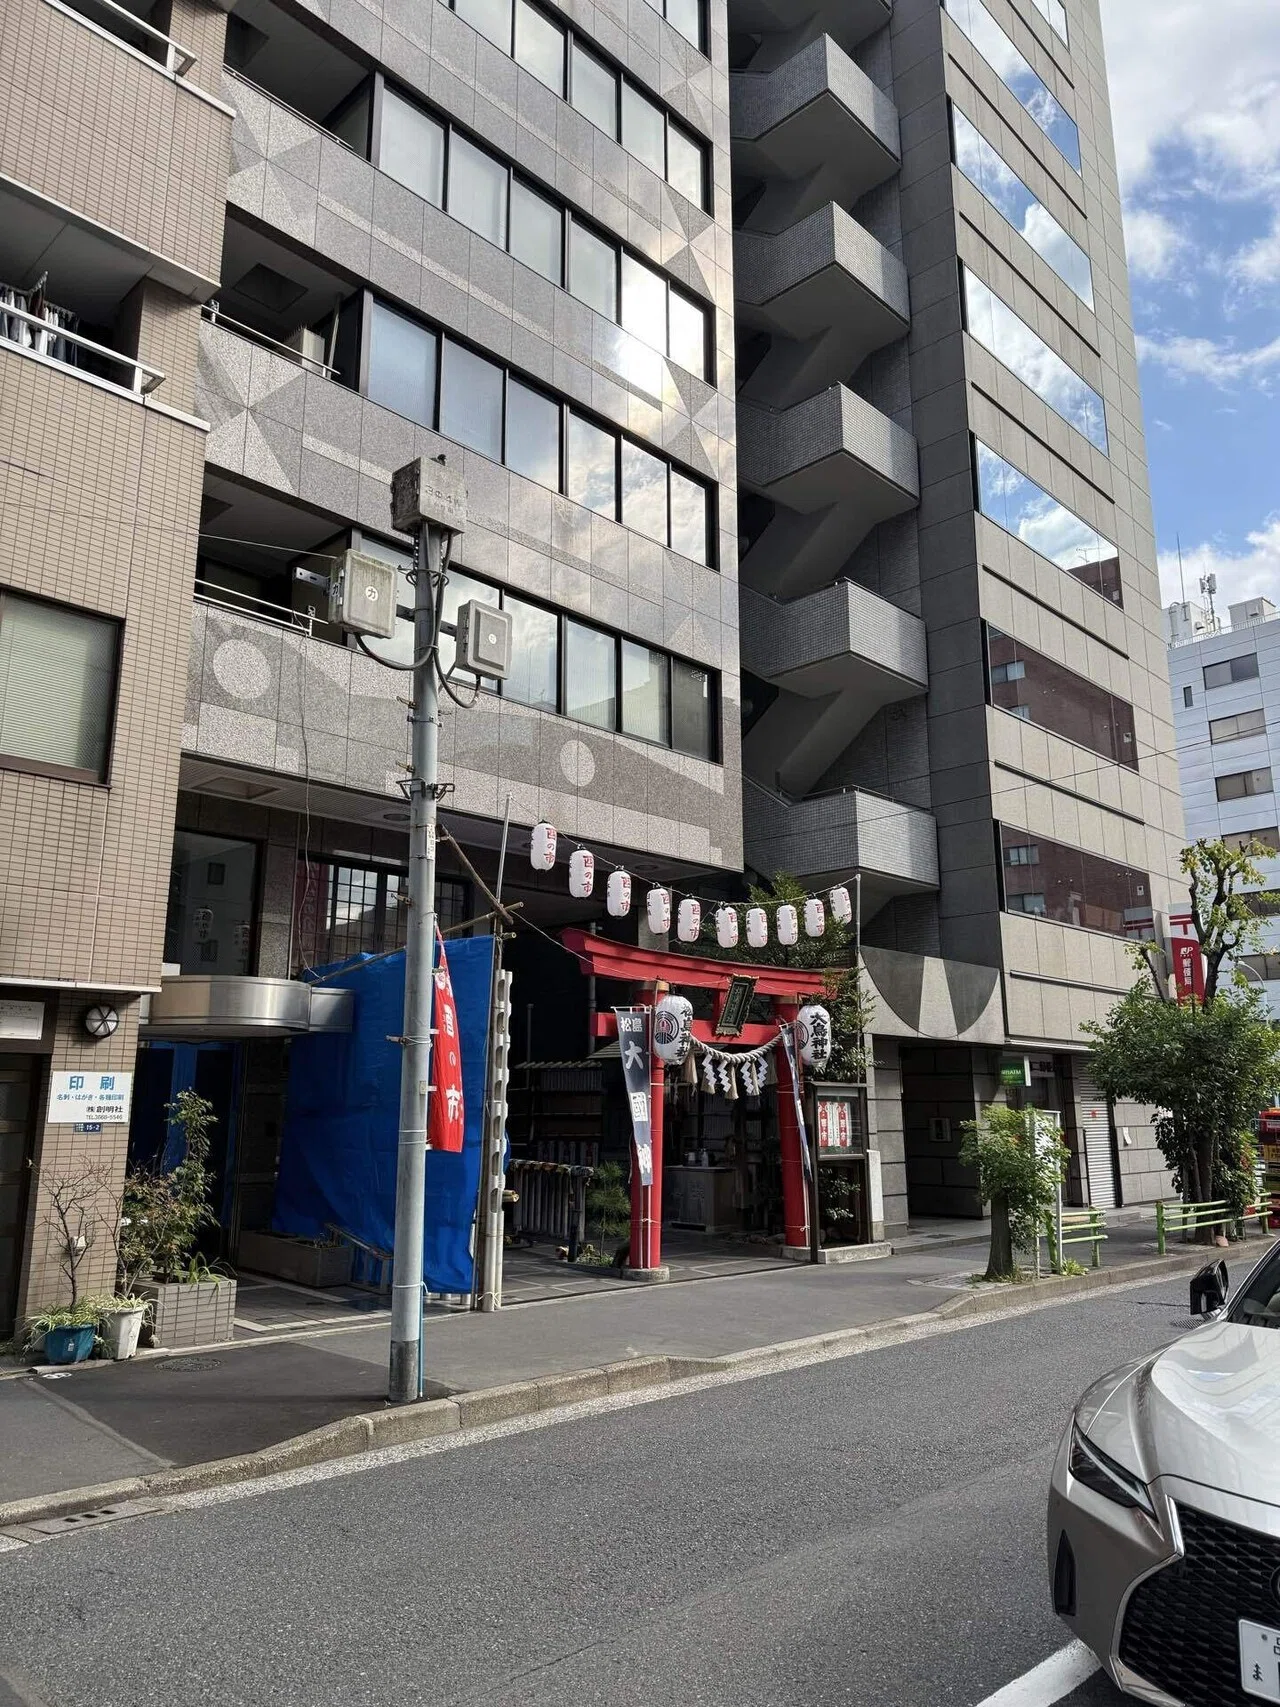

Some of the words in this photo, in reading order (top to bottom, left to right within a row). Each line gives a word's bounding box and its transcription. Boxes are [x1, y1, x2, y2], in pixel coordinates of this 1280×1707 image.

[620, 1017, 643, 1032] 松島
[810, 1012, 828, 1060] 大鳥神社
[69, 1075, 115, 1090] 印刷
[1253, 1663, 1263, 1682] ま
